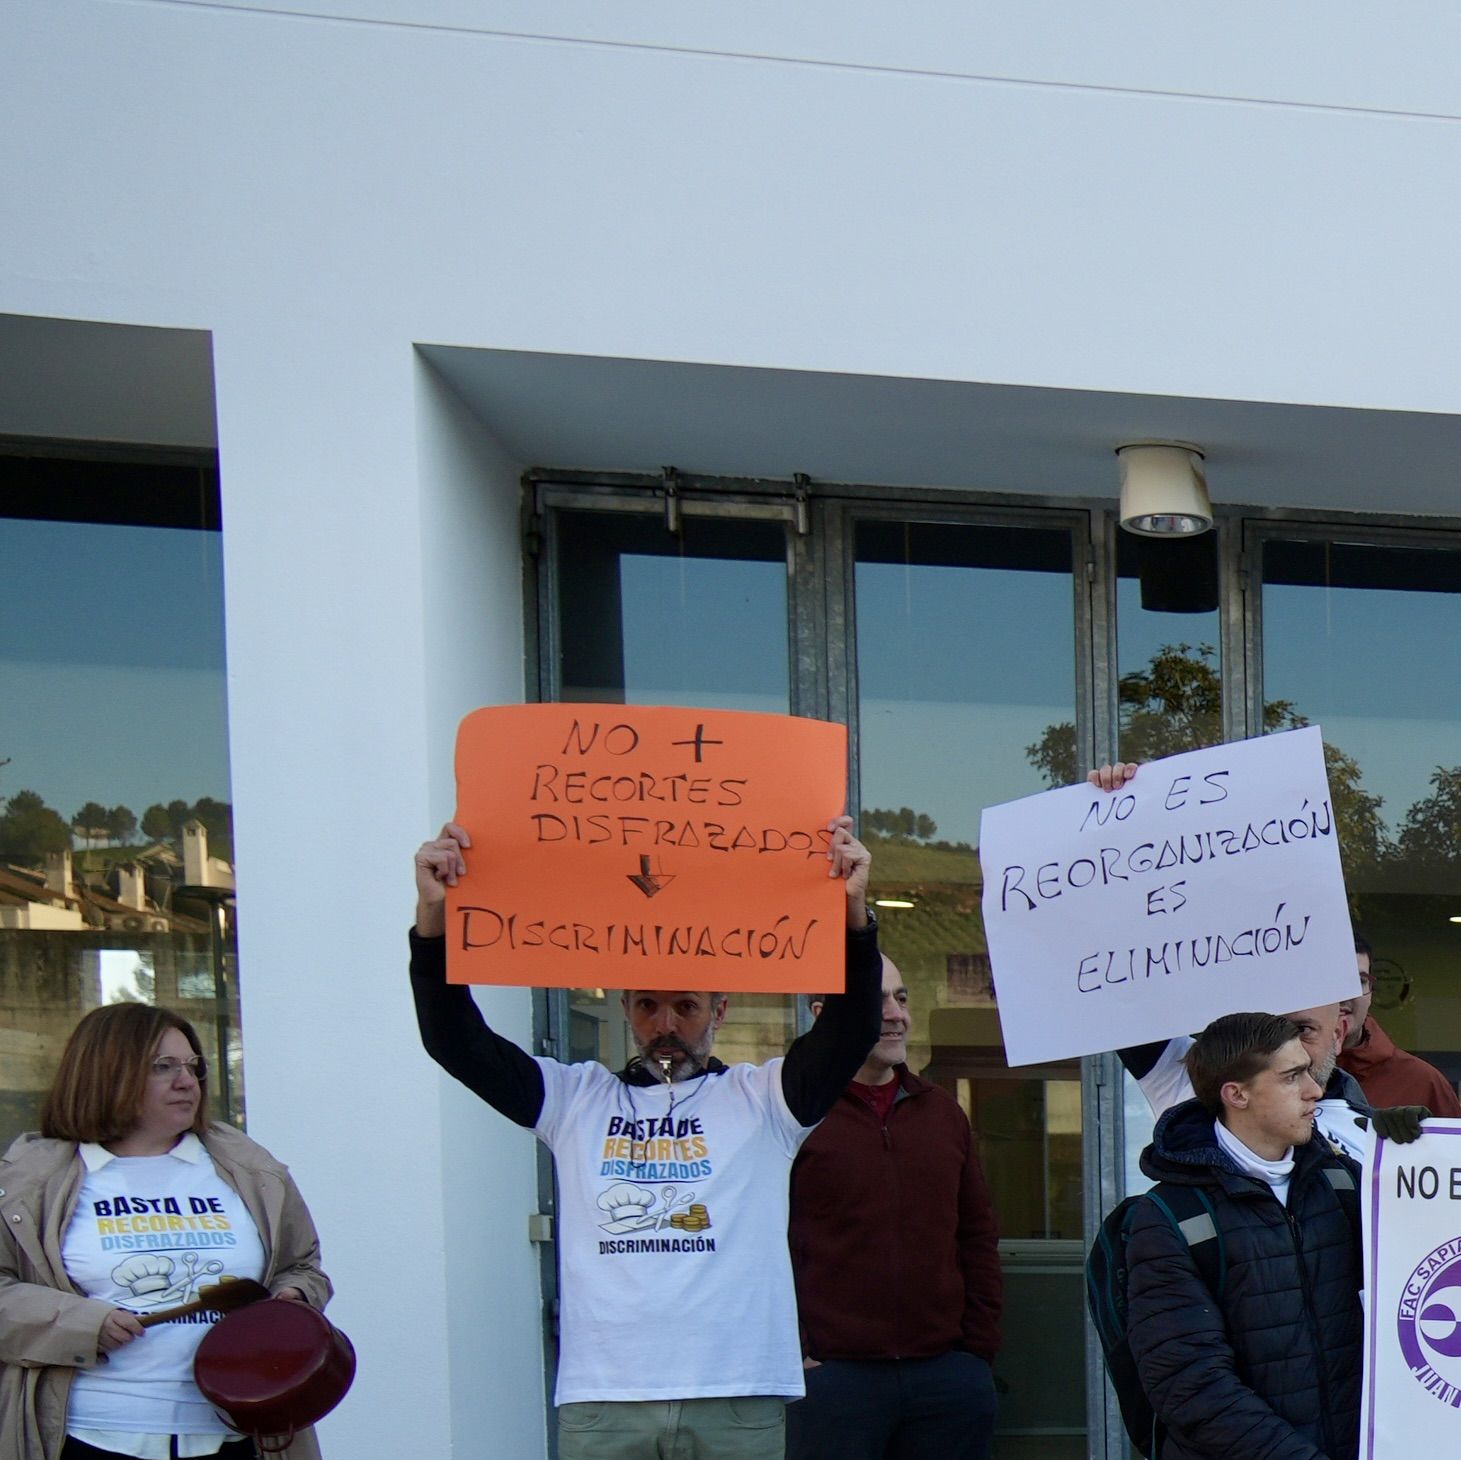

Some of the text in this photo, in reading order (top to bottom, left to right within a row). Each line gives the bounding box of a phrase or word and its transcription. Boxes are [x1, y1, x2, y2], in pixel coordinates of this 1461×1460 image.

[562, 719, 639, 755] NO
[530, 764, 748, 806] RECORTES
[1079, 770, 1229, 832] NO ES
[530, 813, 834, 859] DISFRAZADOS
[1001, 800, 1331, 911] REORGANIZACIÓN
[1147, 880, 1187, 916] ES
[456, 905, 818, 960] DISCRIMINACIÓN
[1078, 903, 1311, 993] ELIMINACIÓN
[607, 1116, 704, 1141] BASTA DE
[602, 1136, 709, 1161] RECORTES
[600, 1159, 713, 1180] DISFRAZADOS
[1397, 1165, 1439, 1200] NO
[93, 1196, 225, 1216] BASTA DE
[97, 1214, 231, 1235] RECORTES
[100, 1231, 237, 1251] DISFRAZADOS
[599, 1236, 716, 1255] DISCRIMINACIÓN
[1400, 1283, 1421, 1320] FAC
[1411, 1364, 1459, 1408] JUAN
